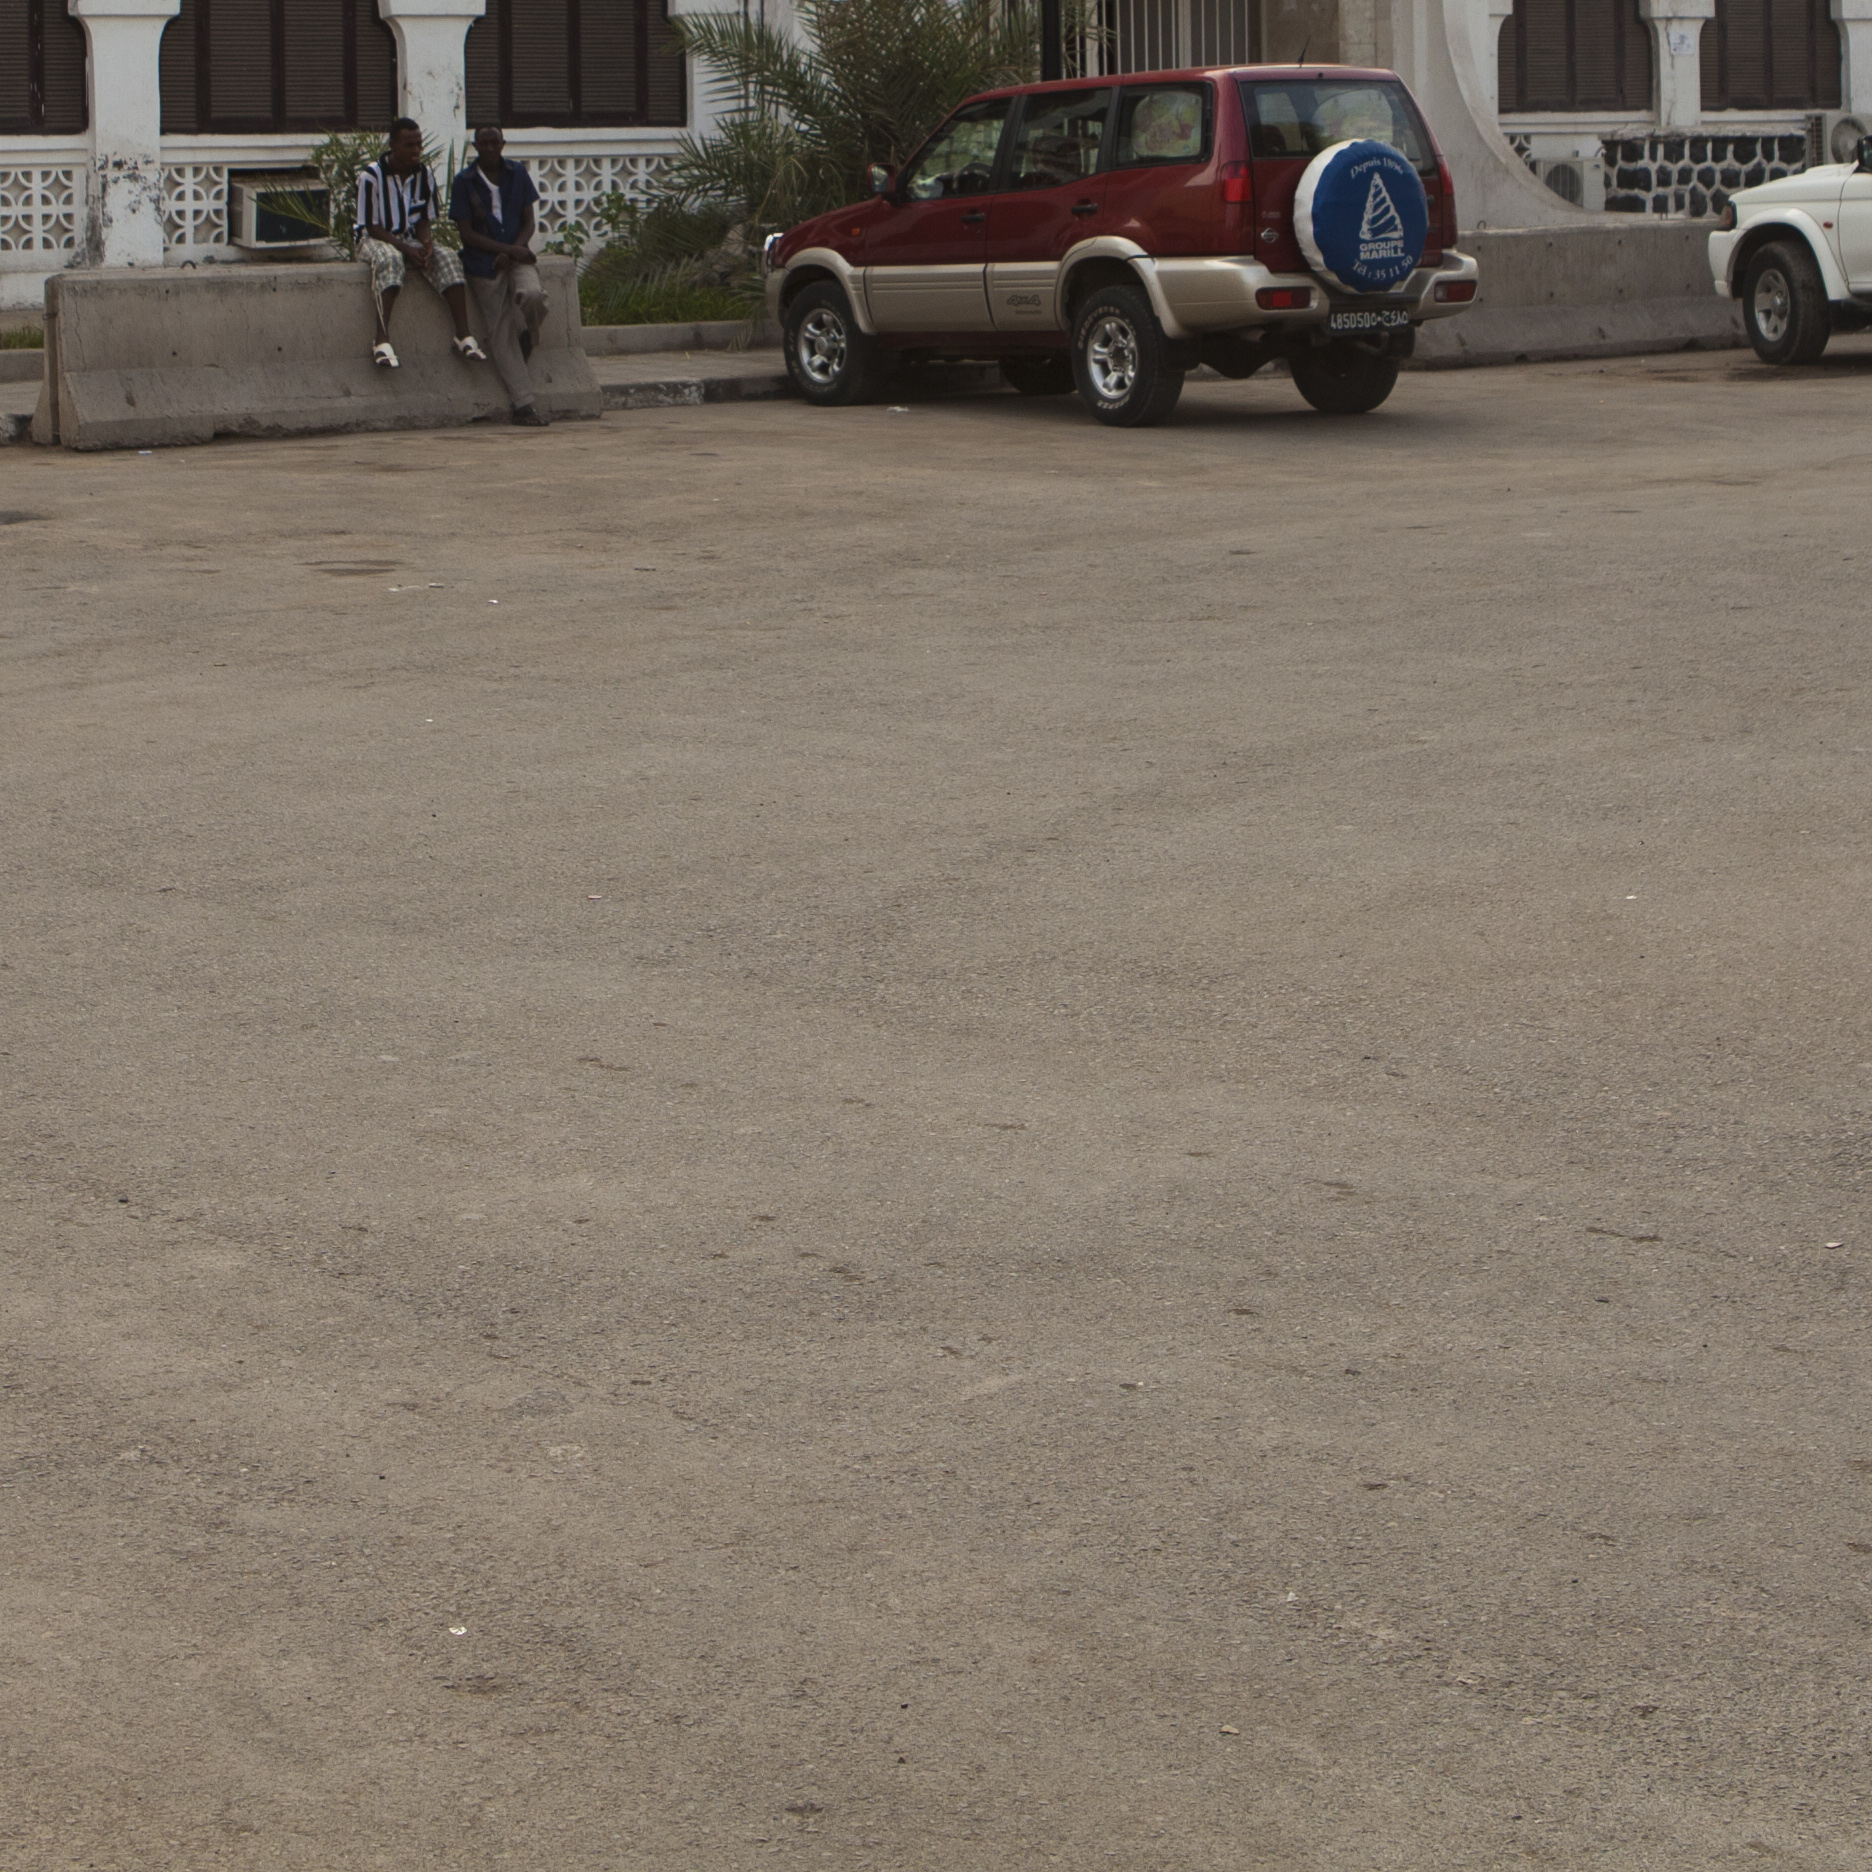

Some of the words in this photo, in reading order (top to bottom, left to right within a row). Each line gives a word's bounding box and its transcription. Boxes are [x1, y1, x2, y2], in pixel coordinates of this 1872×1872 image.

[1350, 156, 1382, 179] Depuis
[1359, 239, 1404, 251] GROUPE
[1359, 247, 1405, 260] MARILL
[1389, 265, 1400, 278] 11
